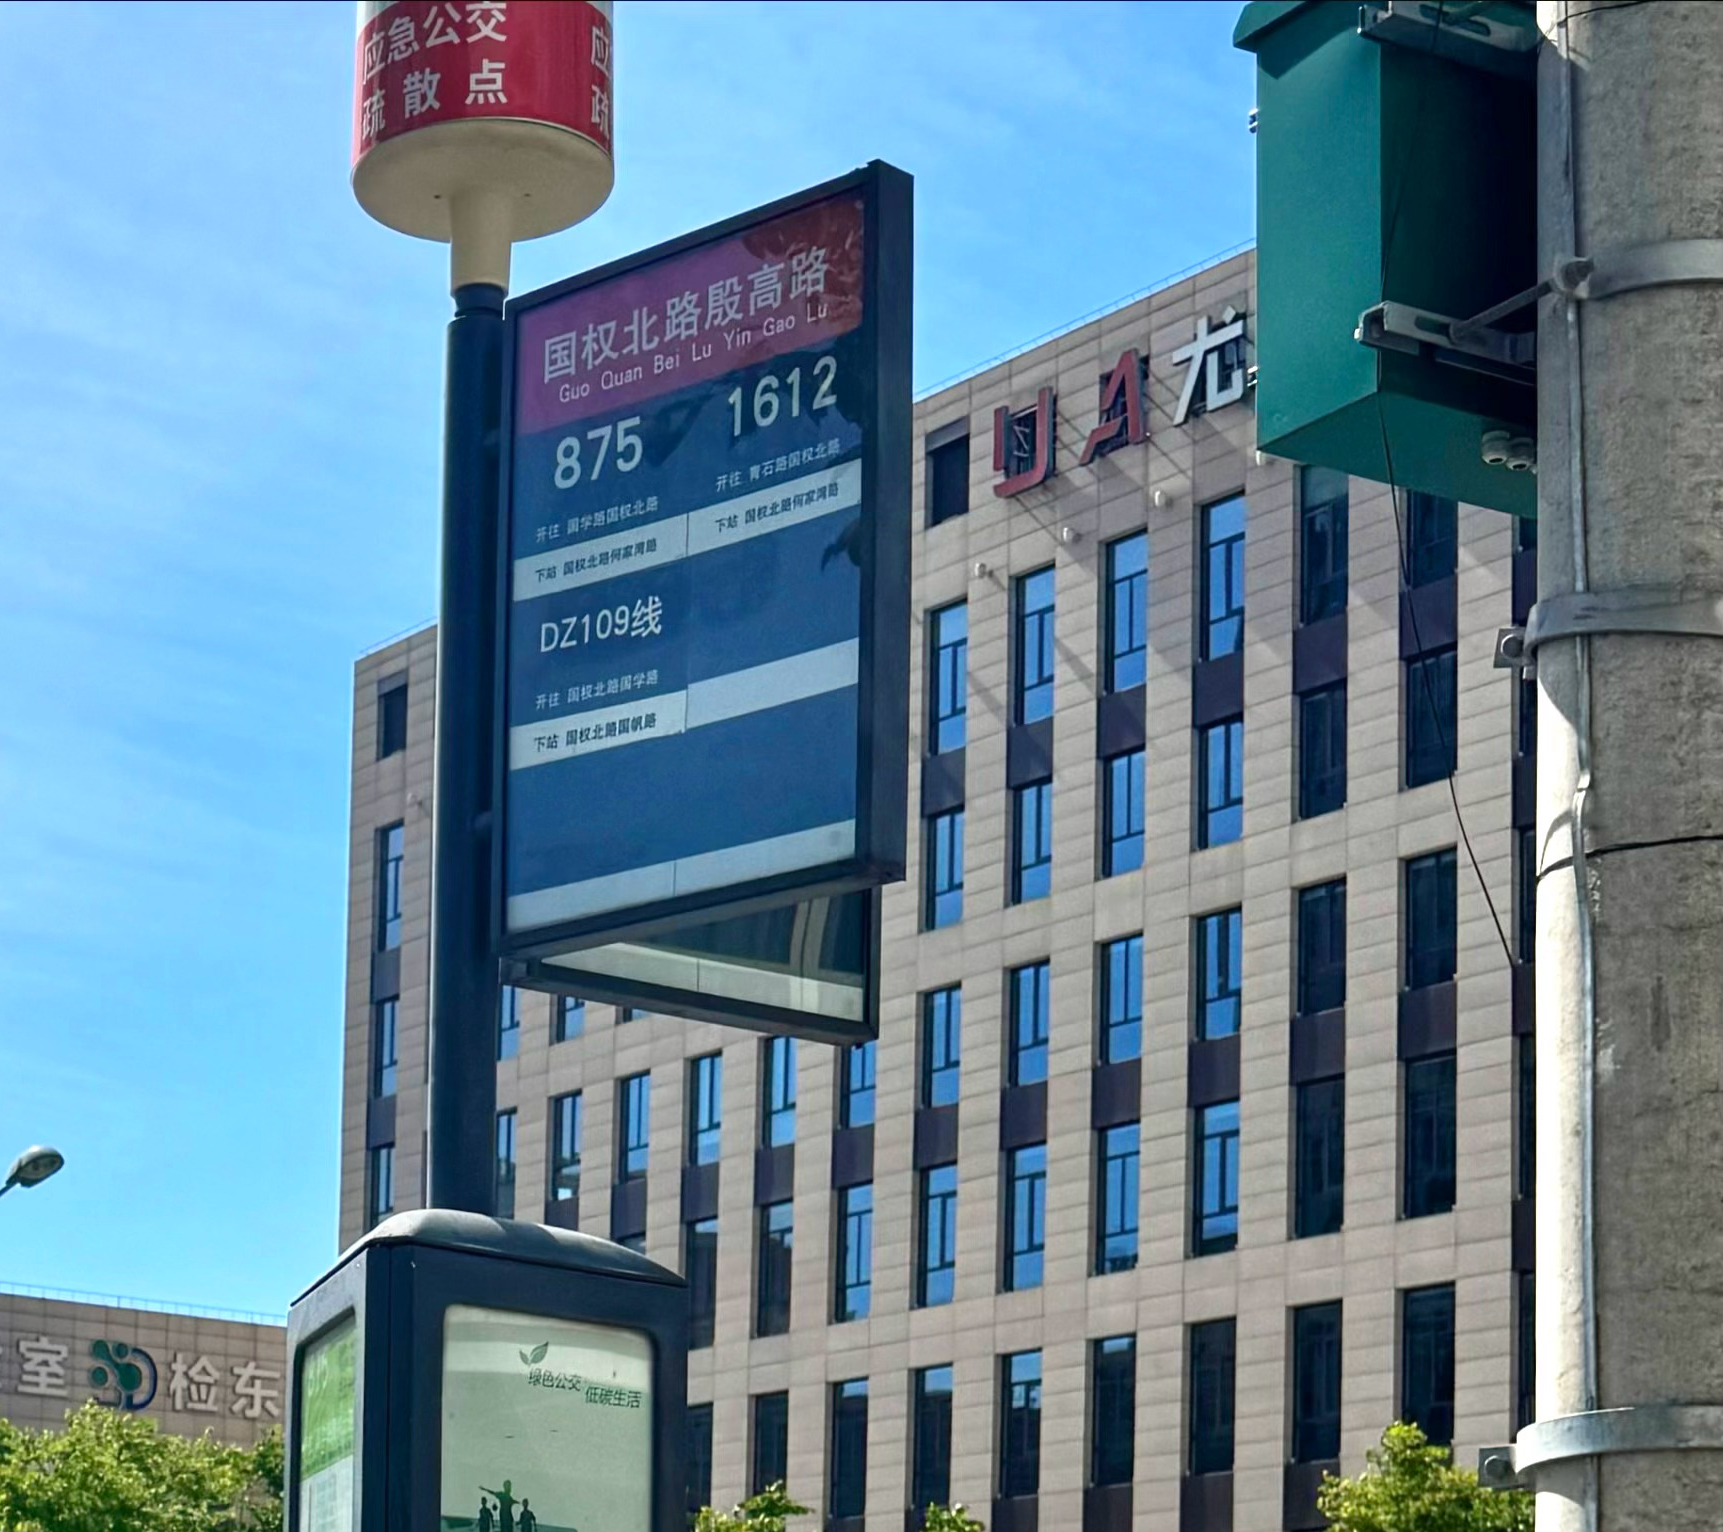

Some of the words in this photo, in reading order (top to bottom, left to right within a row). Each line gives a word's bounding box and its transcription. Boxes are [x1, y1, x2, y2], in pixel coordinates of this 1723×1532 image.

[363, 0, 507, 85] 应急公交
[362, 58, 508, 140] 疏散点
[544, 245, 828, 384] 国权北路殷高路
[559, 382, 590, 403] Guo
[601, 367, 643, 390] Quan
[653, 353, 679, 375] Bei
[692, 342, 712, 362] Lu
[723, 329, 752, 351] Yin
[762, 315, 796, 337] Gao
[807, 302, 828, 323] Lu
[728, 355, 837, 436] 1612
[554, 416, 643, 489] 875
[540, 595, 663, 653] DZ109线
[585, 1386, 642, 1409] 低碳生活
